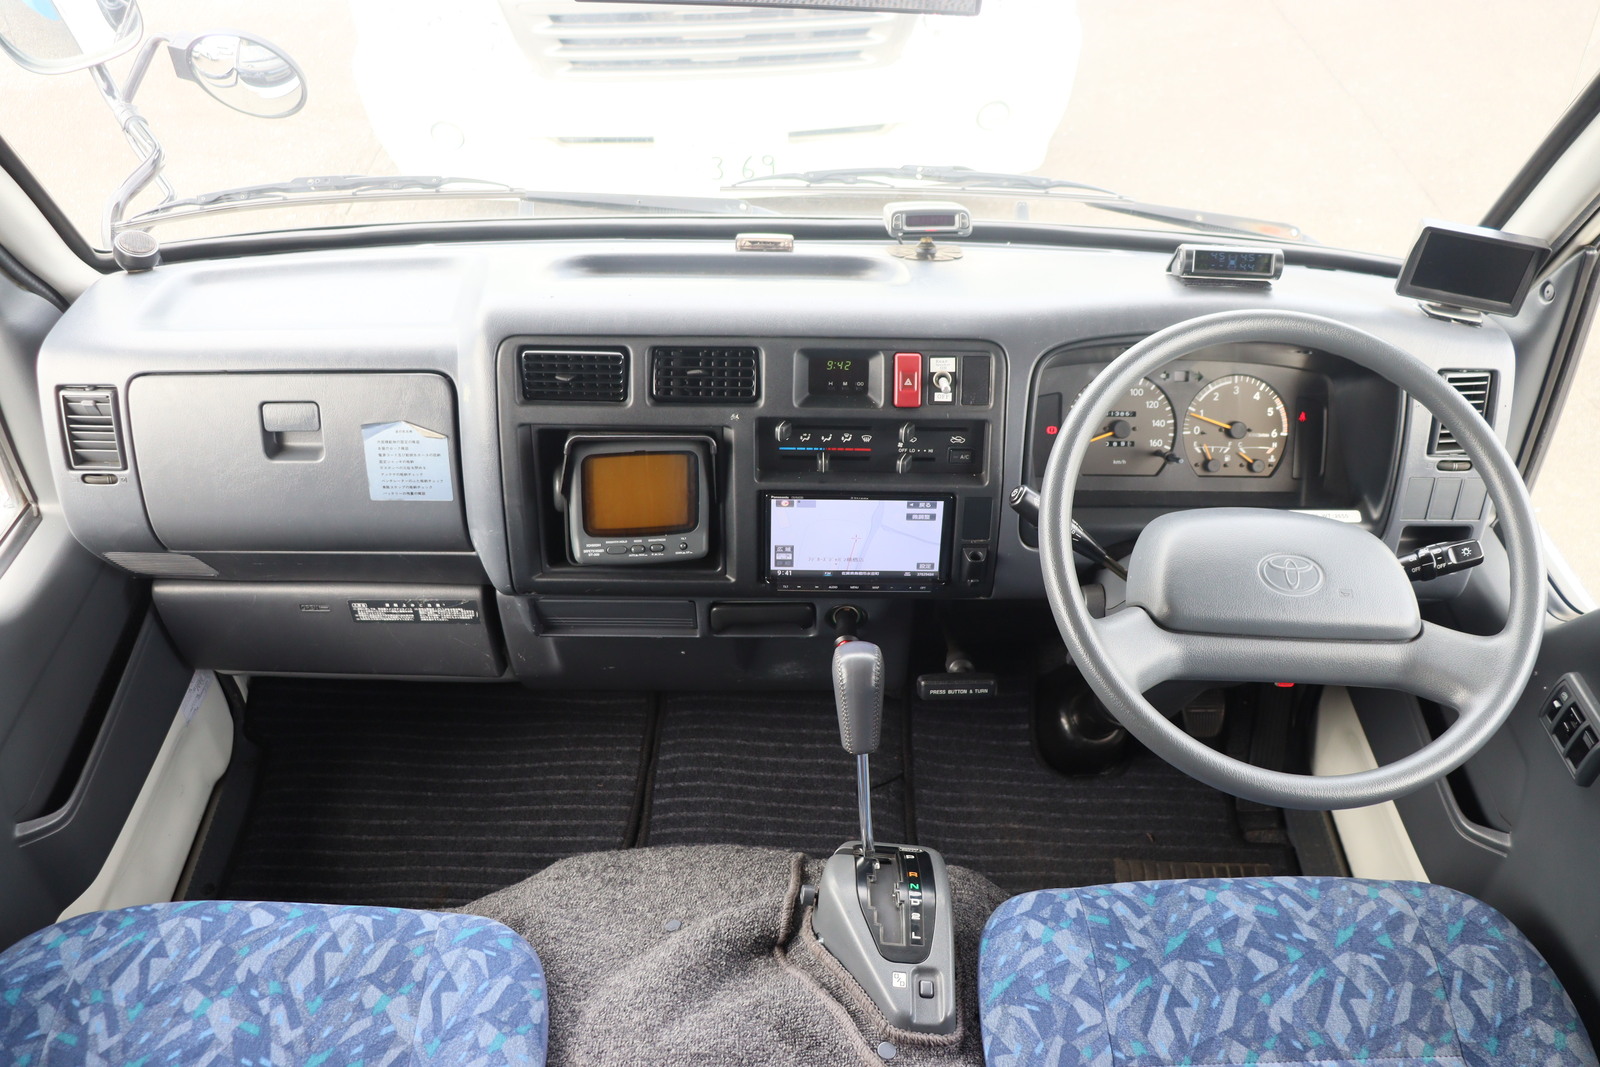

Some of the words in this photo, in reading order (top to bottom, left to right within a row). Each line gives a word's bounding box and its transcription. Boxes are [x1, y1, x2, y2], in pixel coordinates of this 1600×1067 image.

[827, 360, 851, 370] 9:42
[1130, 388, 1144, 396] 100
[1233, 385, 1240, 395] 3
[1213, 392, 1220, 401] 2
[1253, 391, 1260, 401] 4
[1146, 401, 1159, 409] 120
[1199, 409, 1204, 417] 1
[1267, 407, 1274, 417] 5
[1152, 419, 1165, 427] 140
[1193, 425, 1200, 435] 0
[1270, 428, 1278, 438] 6
[1149, 439, 1163, 447] 160
[1436, 562, 1446, 570] OFF
[912, 931, 921, 939] L
